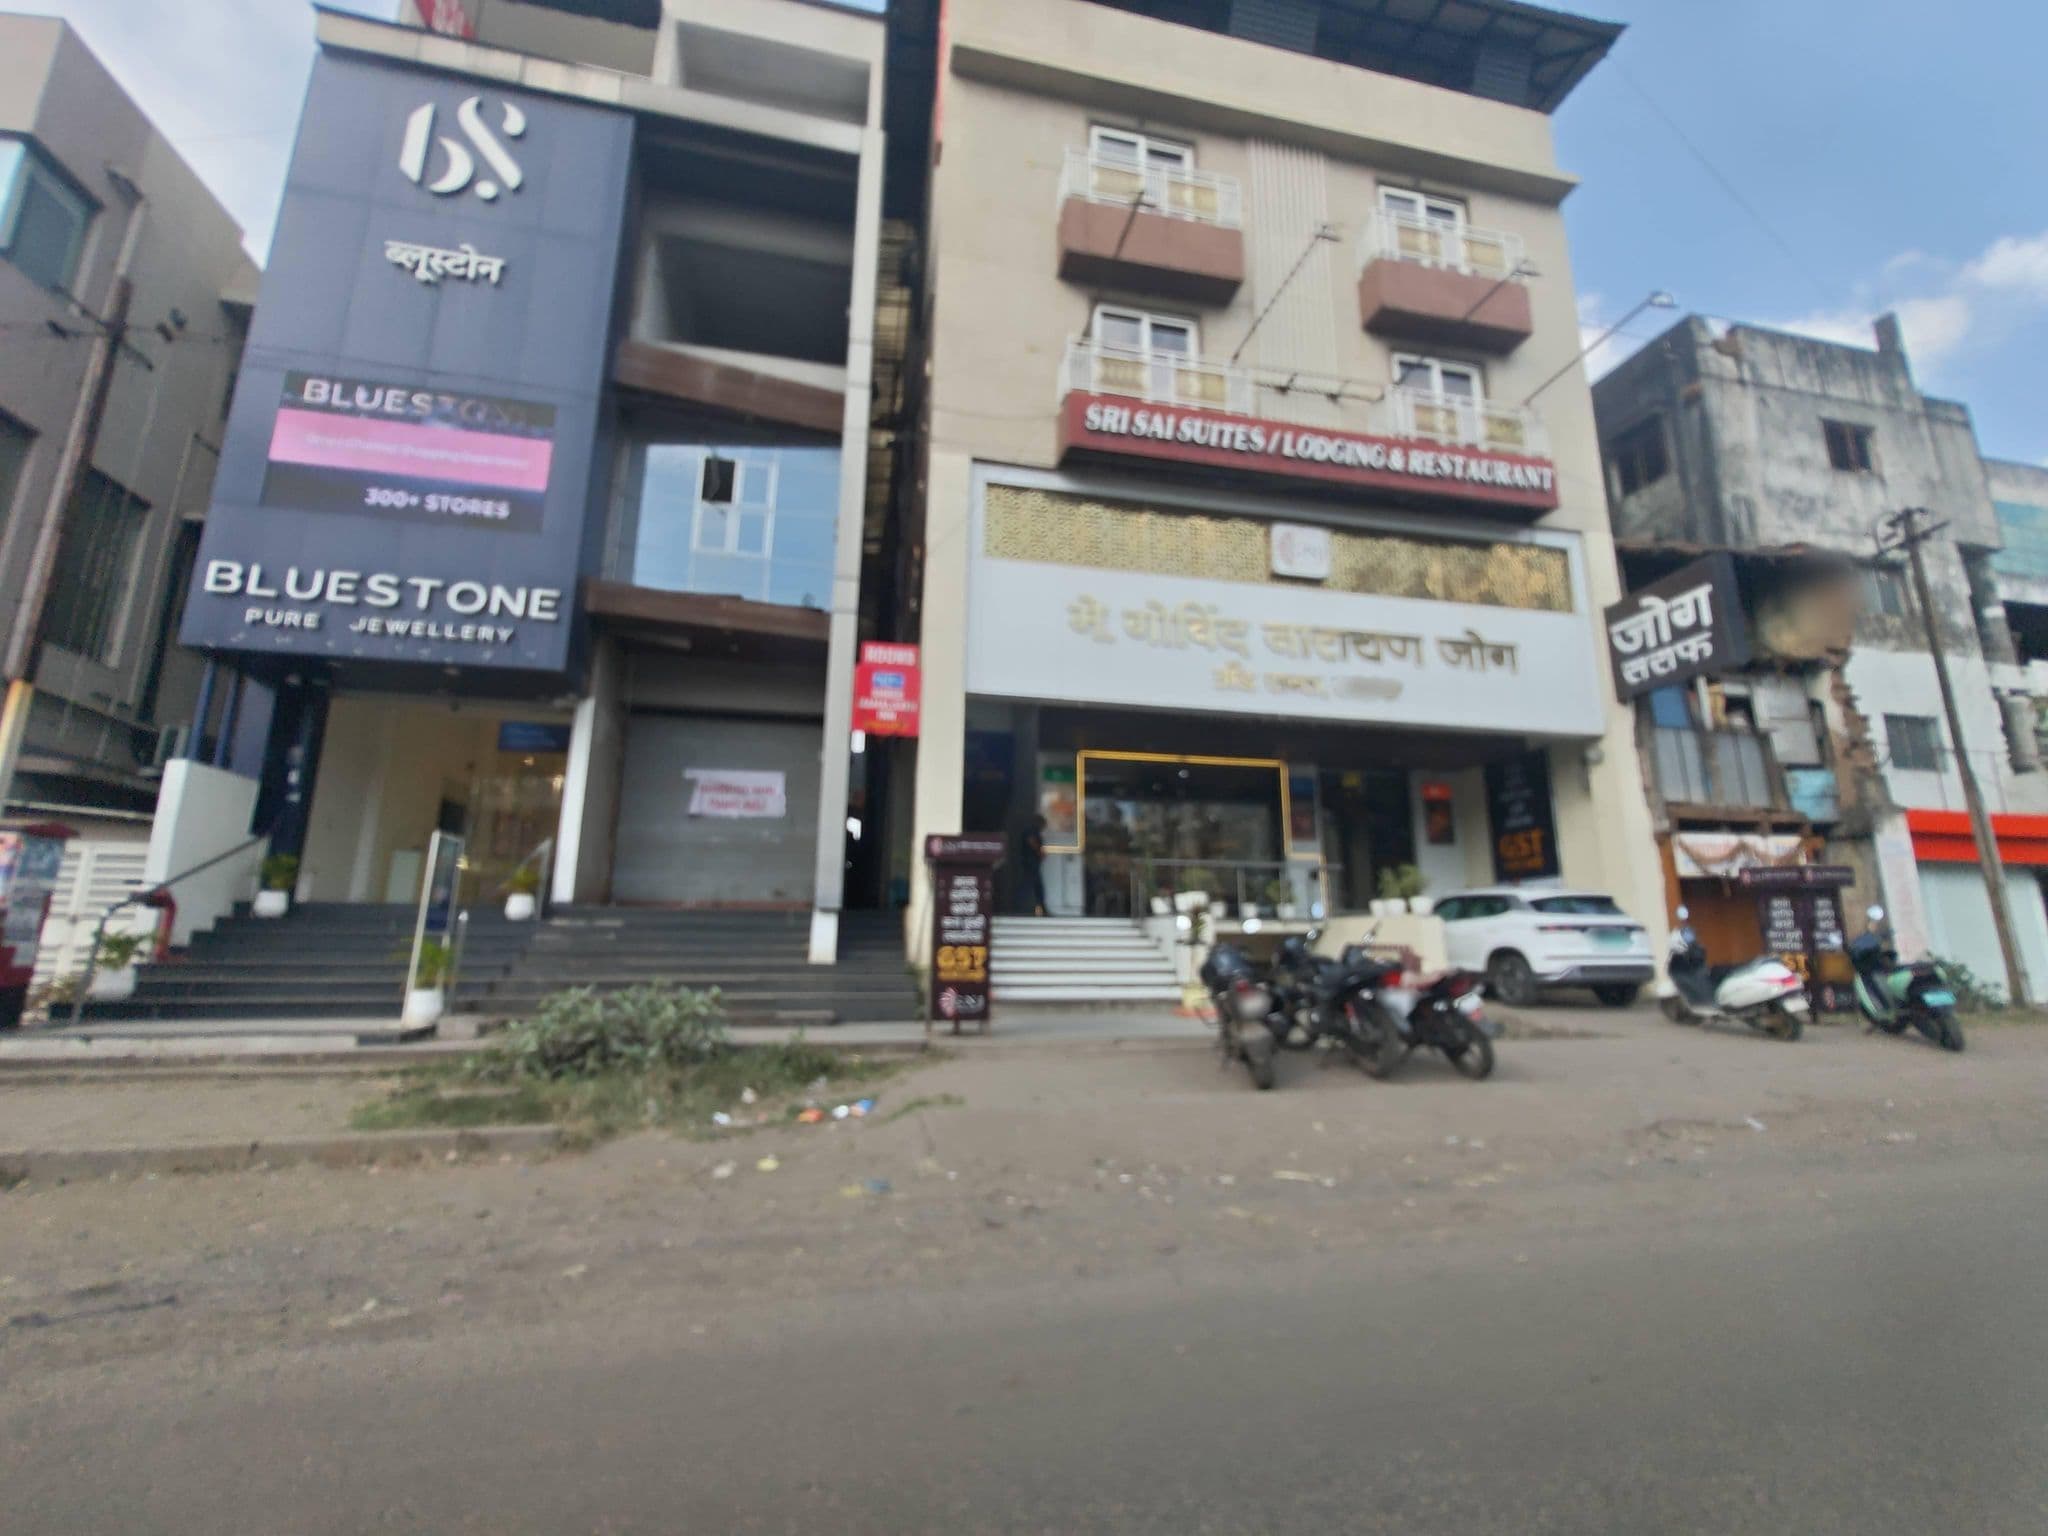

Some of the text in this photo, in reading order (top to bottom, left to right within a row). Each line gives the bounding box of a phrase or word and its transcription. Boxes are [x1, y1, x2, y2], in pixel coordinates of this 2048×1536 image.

[1085, 402, 1129, 435] SRI
[1131, 411, 1175, 441] SAI
[1176, 416, 1265, 452] SUITES
[1281, 430, 1385, 470] LODGING
[1386, 446, 1405, 472] &
[1407, 448, 1553, 491] RESTAURANT
[423, 494, 510, 520] STORES
[204, 559, 561, 621] BLUESTONE
[245, 607, 514, 644] PURE JEWELLERY
[1609, 582, 1714, 653] जोग
[1437, 628, 1520, 674] जोग
